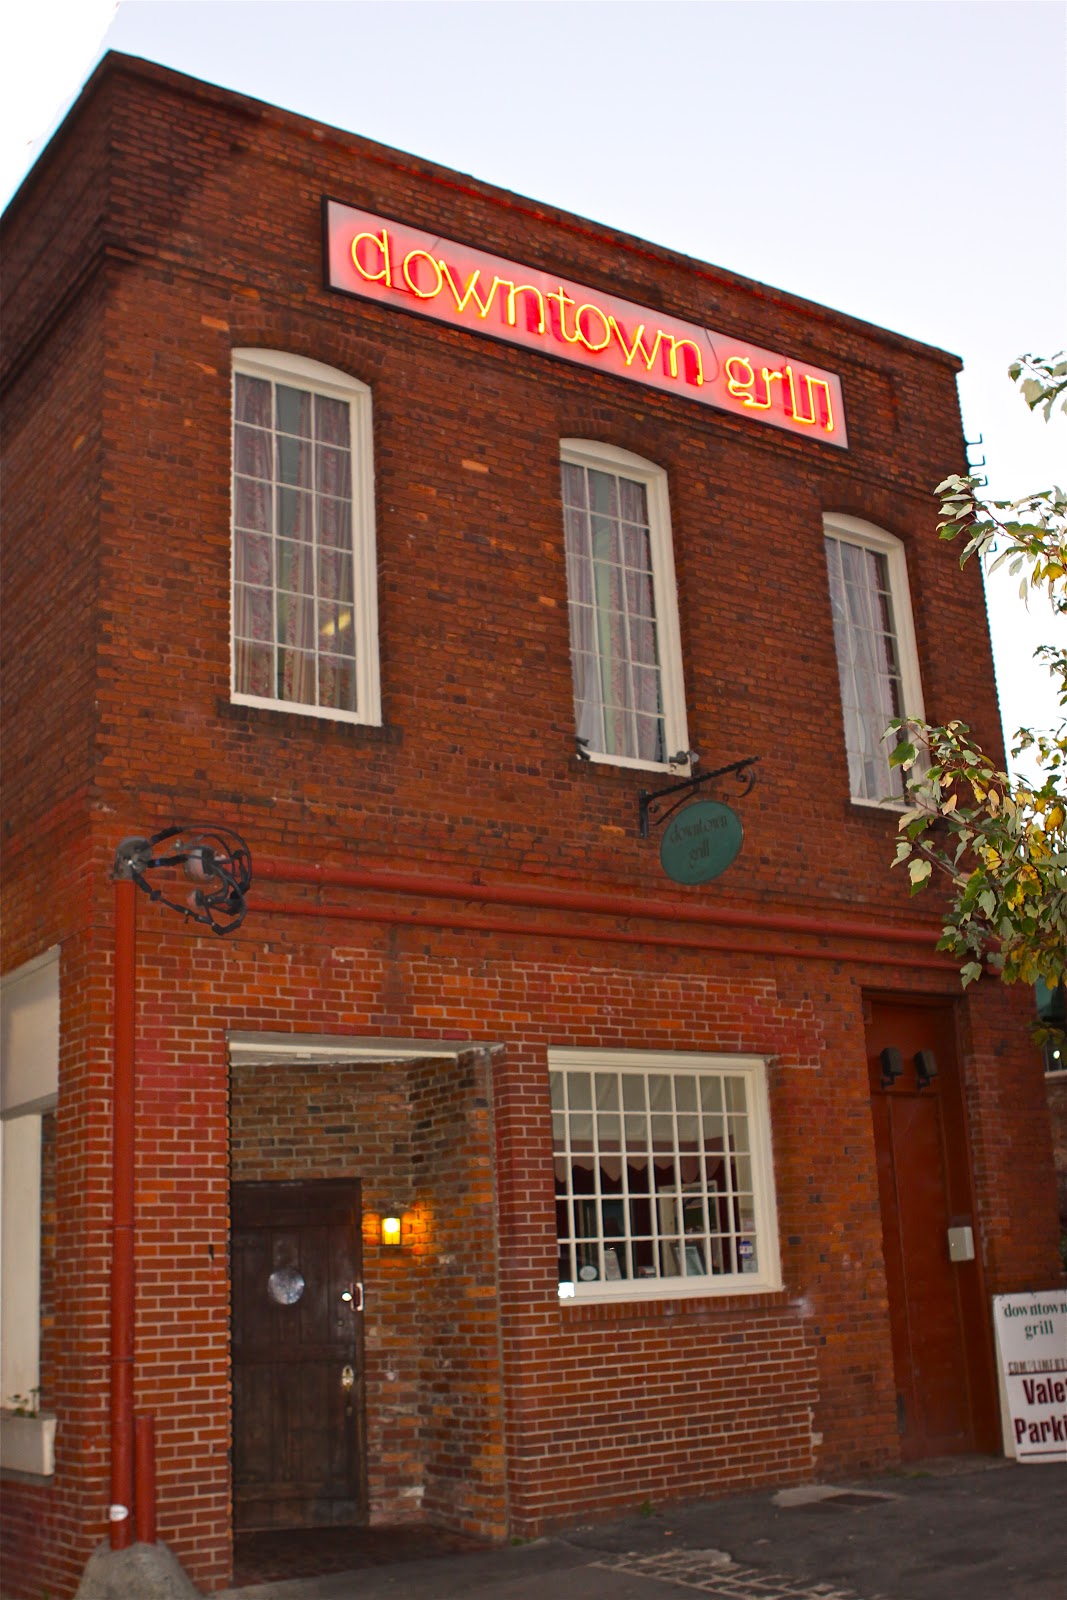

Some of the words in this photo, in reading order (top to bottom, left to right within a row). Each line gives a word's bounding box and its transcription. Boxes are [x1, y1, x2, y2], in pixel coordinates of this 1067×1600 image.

[350, 228, 703, 386] downtown
[725, 356, 834, 432] grill
[670, 816, 728, 843] downtown
[688, 839, 710, 869] grill
[1004, 1303, 1067, 1317] downtown
[1025, 1319, 1054, 1340] grill
[1008, 1359, 1067, 1374] COMLIMENT
[1023, 1378, 1067, 1405] Vale
